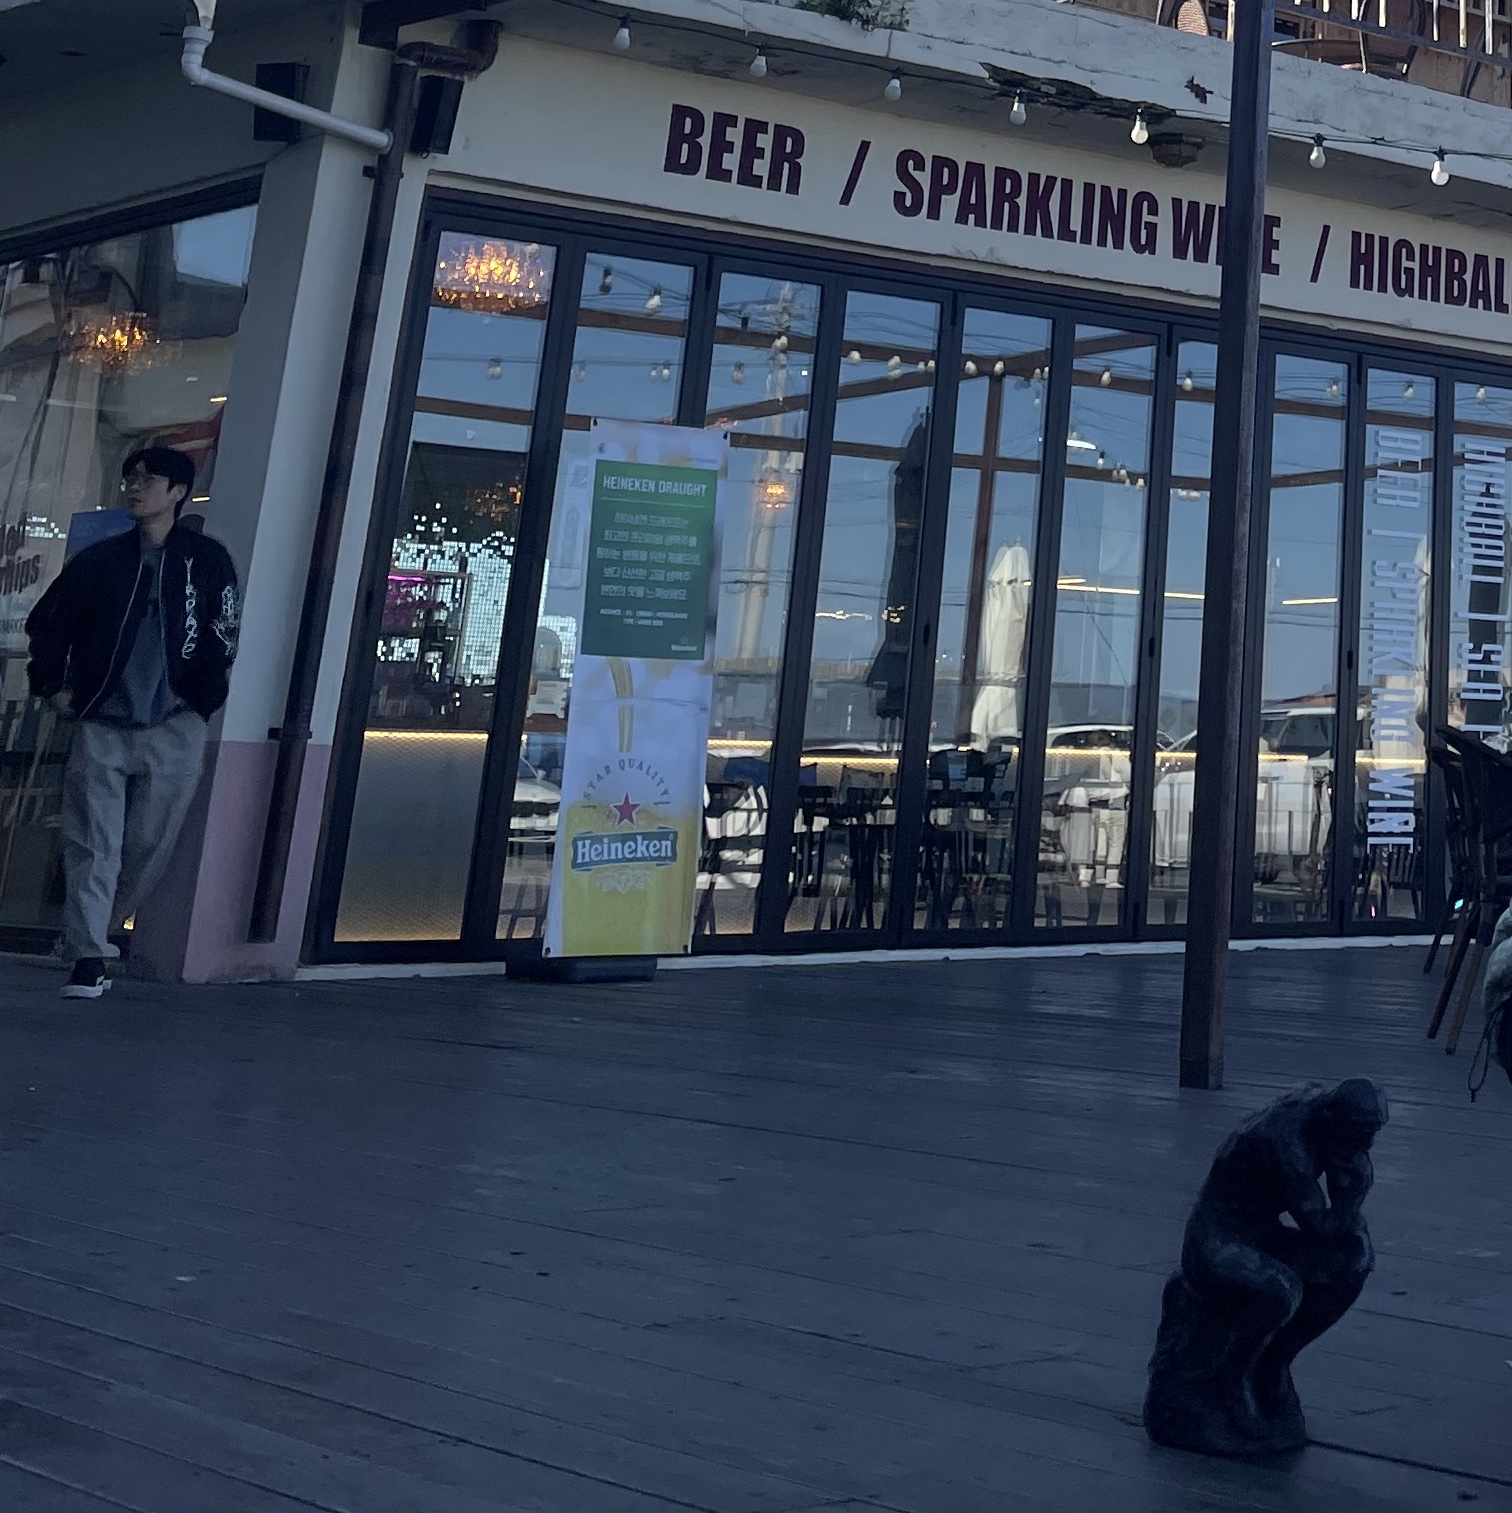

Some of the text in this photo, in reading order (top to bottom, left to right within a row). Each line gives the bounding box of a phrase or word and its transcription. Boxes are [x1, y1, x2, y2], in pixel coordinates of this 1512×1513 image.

[664, 103, 805, 196] BEER
[894, 148, 1159, 256] SPARKLING
[1171, 197, 1281, 276] WIE
[603, 474, 656, 494] HEINEKEN
[658, 480, 708, 498] DRAUGHT
[1463, 441, 1506, 585] HIGHBALL
[583, 758, 671, 800] STAR QUALITY
[576, 833, 673, 865] Heineken
